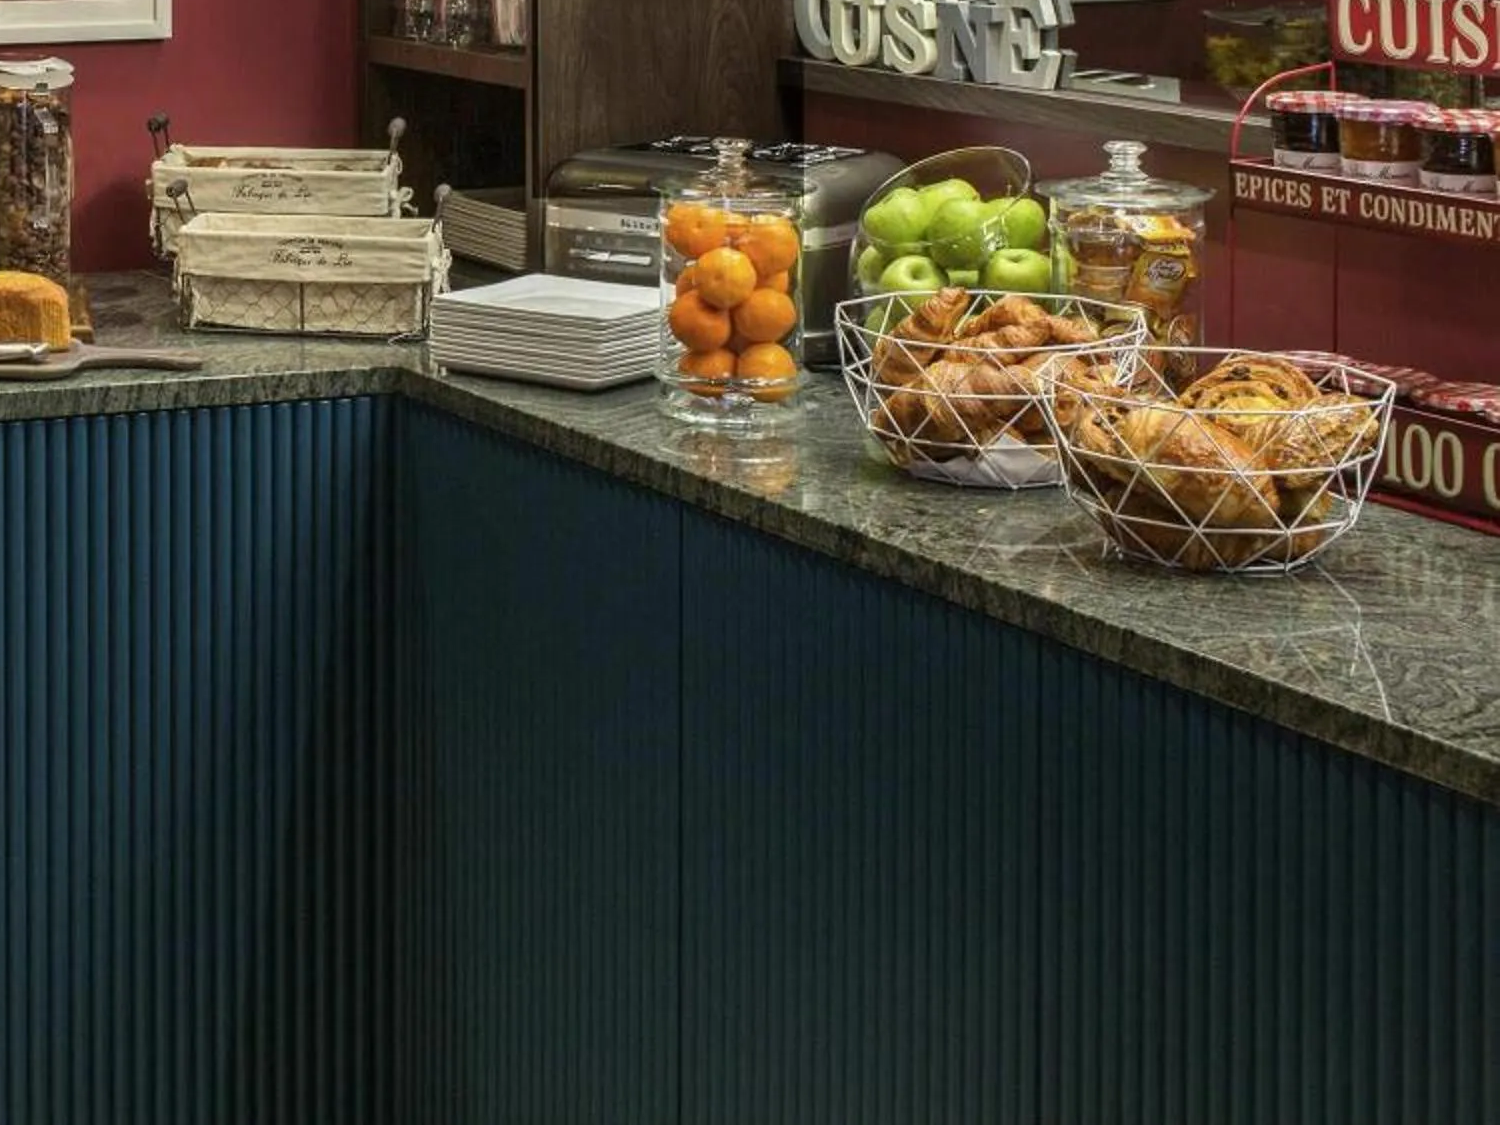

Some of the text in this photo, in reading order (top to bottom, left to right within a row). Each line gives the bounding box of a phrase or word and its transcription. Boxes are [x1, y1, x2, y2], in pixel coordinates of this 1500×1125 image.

[1234, 172, 1312, 209] EPICES
[1320, 185, 1351, 216] ET
[1382, 419, 1464, 498] 100
